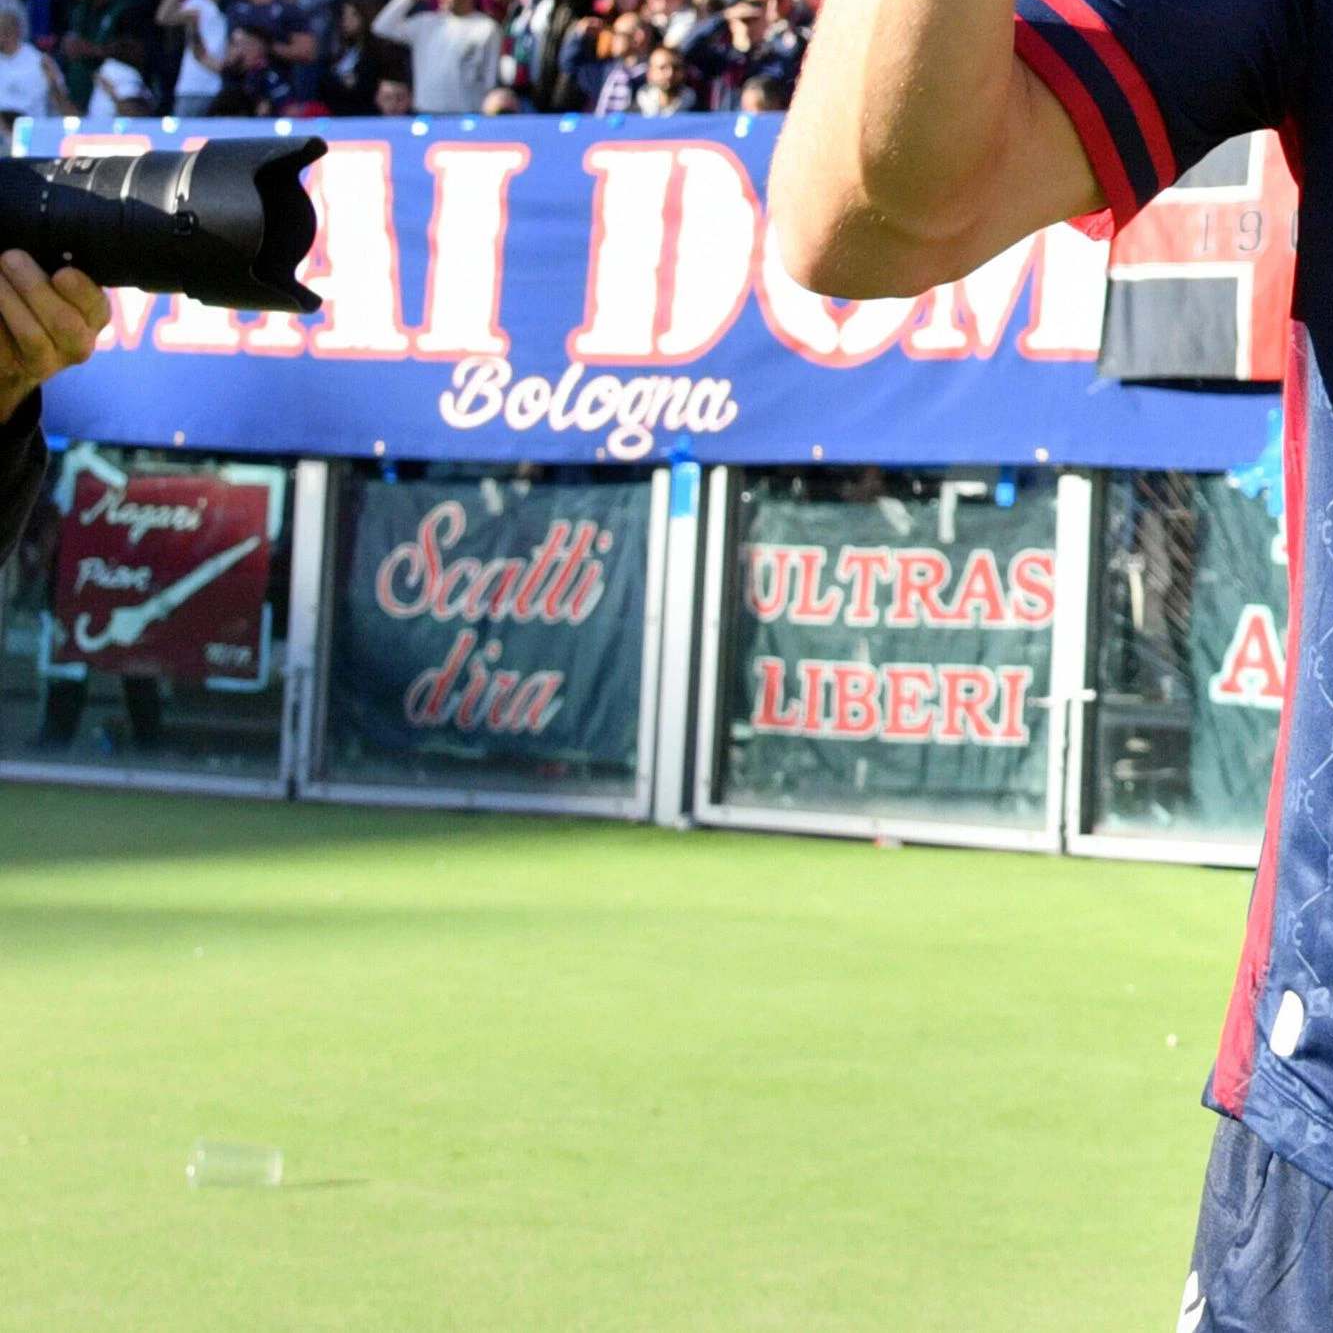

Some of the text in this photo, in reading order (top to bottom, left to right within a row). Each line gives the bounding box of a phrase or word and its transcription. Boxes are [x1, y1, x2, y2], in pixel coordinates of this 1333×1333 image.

[440, 356, 737, 459] Bologna
[376, 501, 612, 625] Scatti
[750, 544, 1057, 628] ULTRAS
[754, 655, 1033, 745] LIBERI
